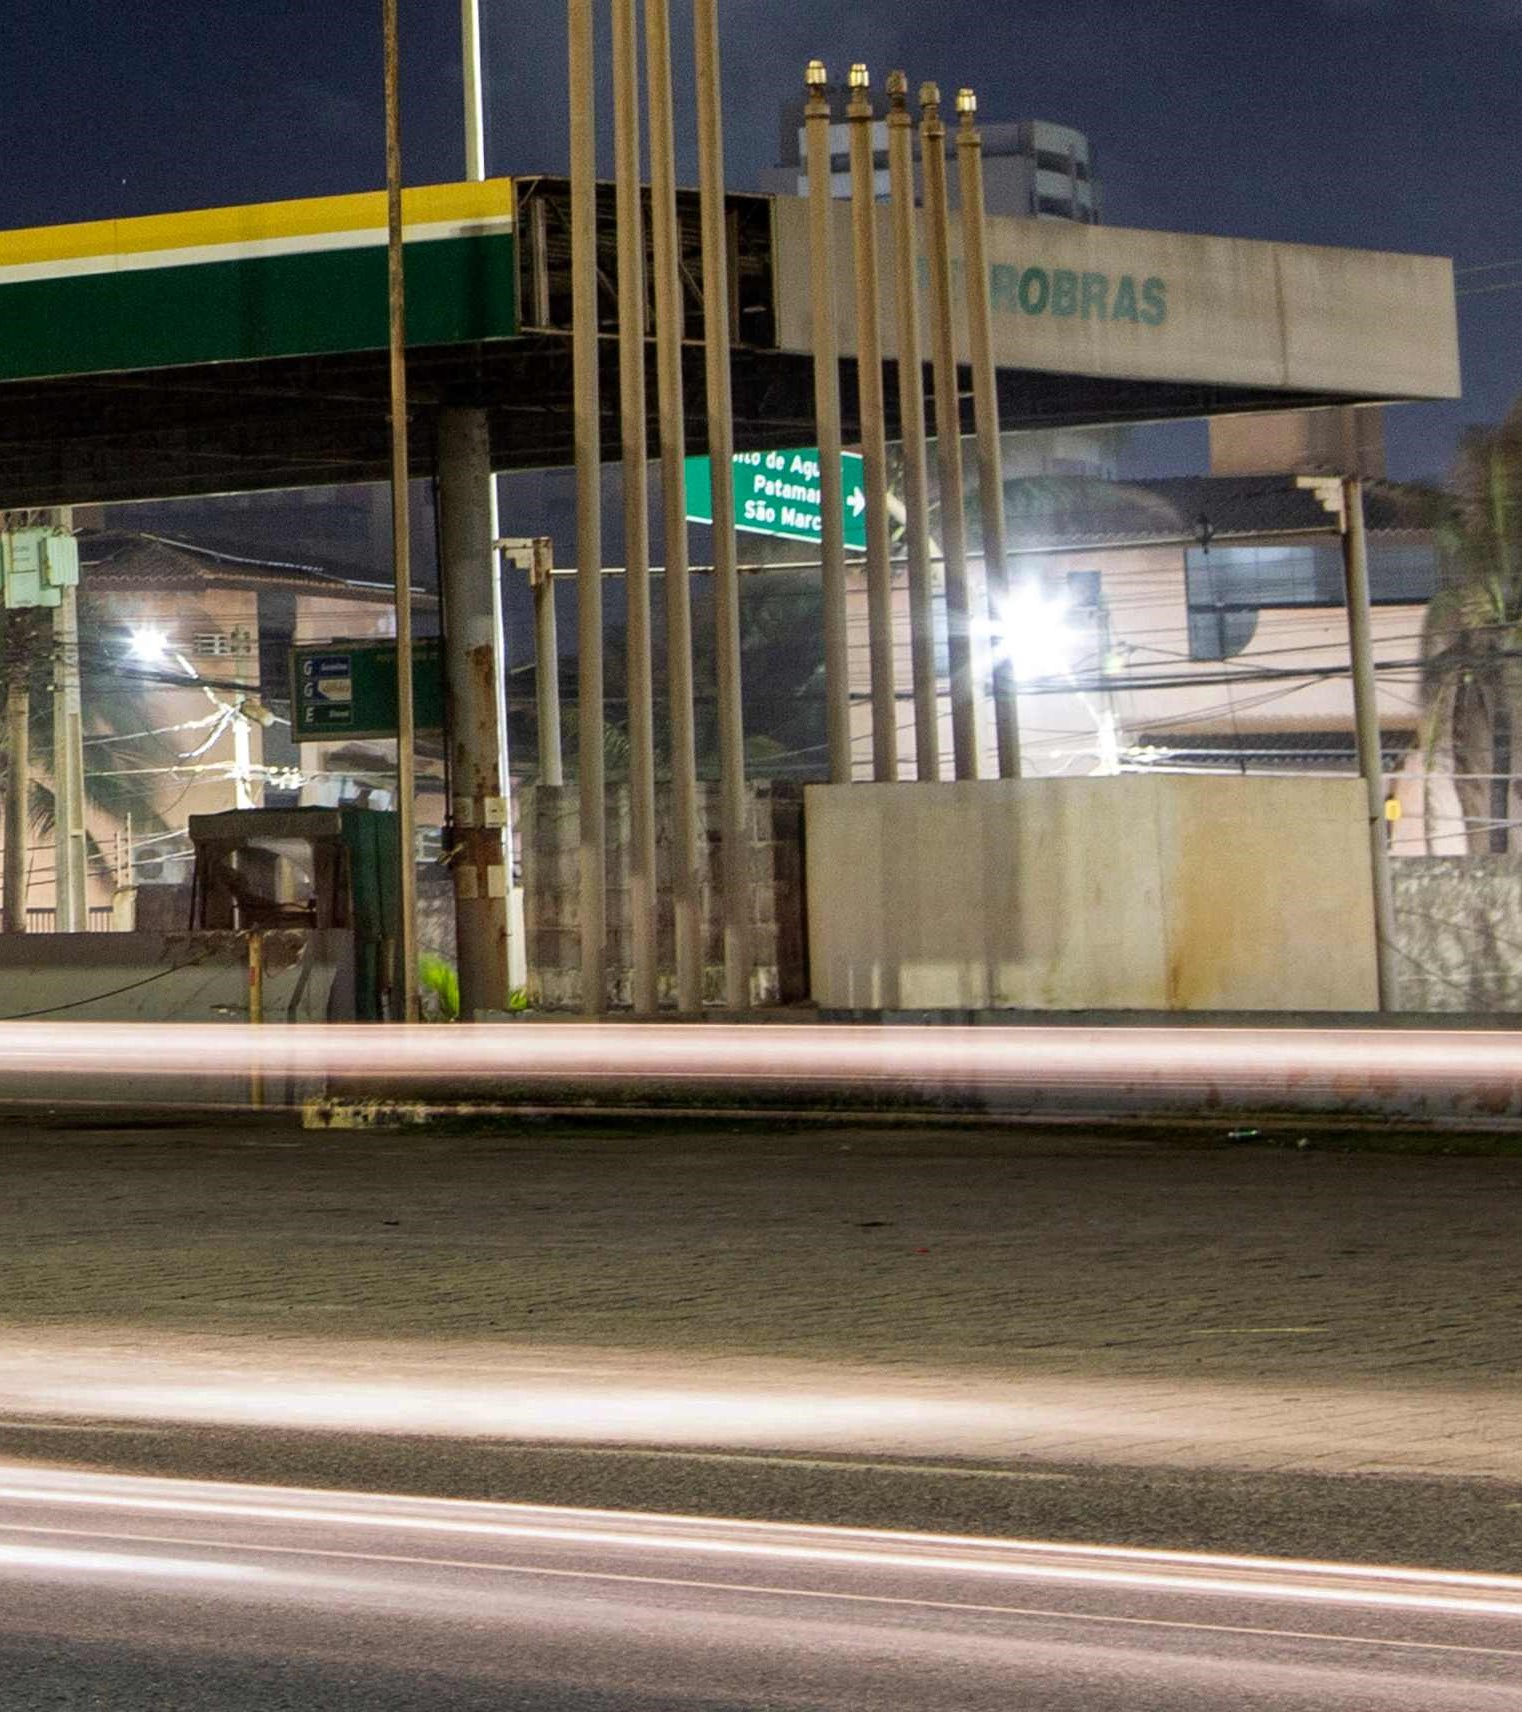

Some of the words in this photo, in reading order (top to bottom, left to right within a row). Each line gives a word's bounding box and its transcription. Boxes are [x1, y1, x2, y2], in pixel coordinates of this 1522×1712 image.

[915, 254, 1167, 327] ROBRAS
[765, 451, 786, 471] de
[753, 474, 822, 506] Patamar
[744, 499, 776, 523] São
[781, 506, 823, 532] Marc
[305, 706, 315, 723] E
